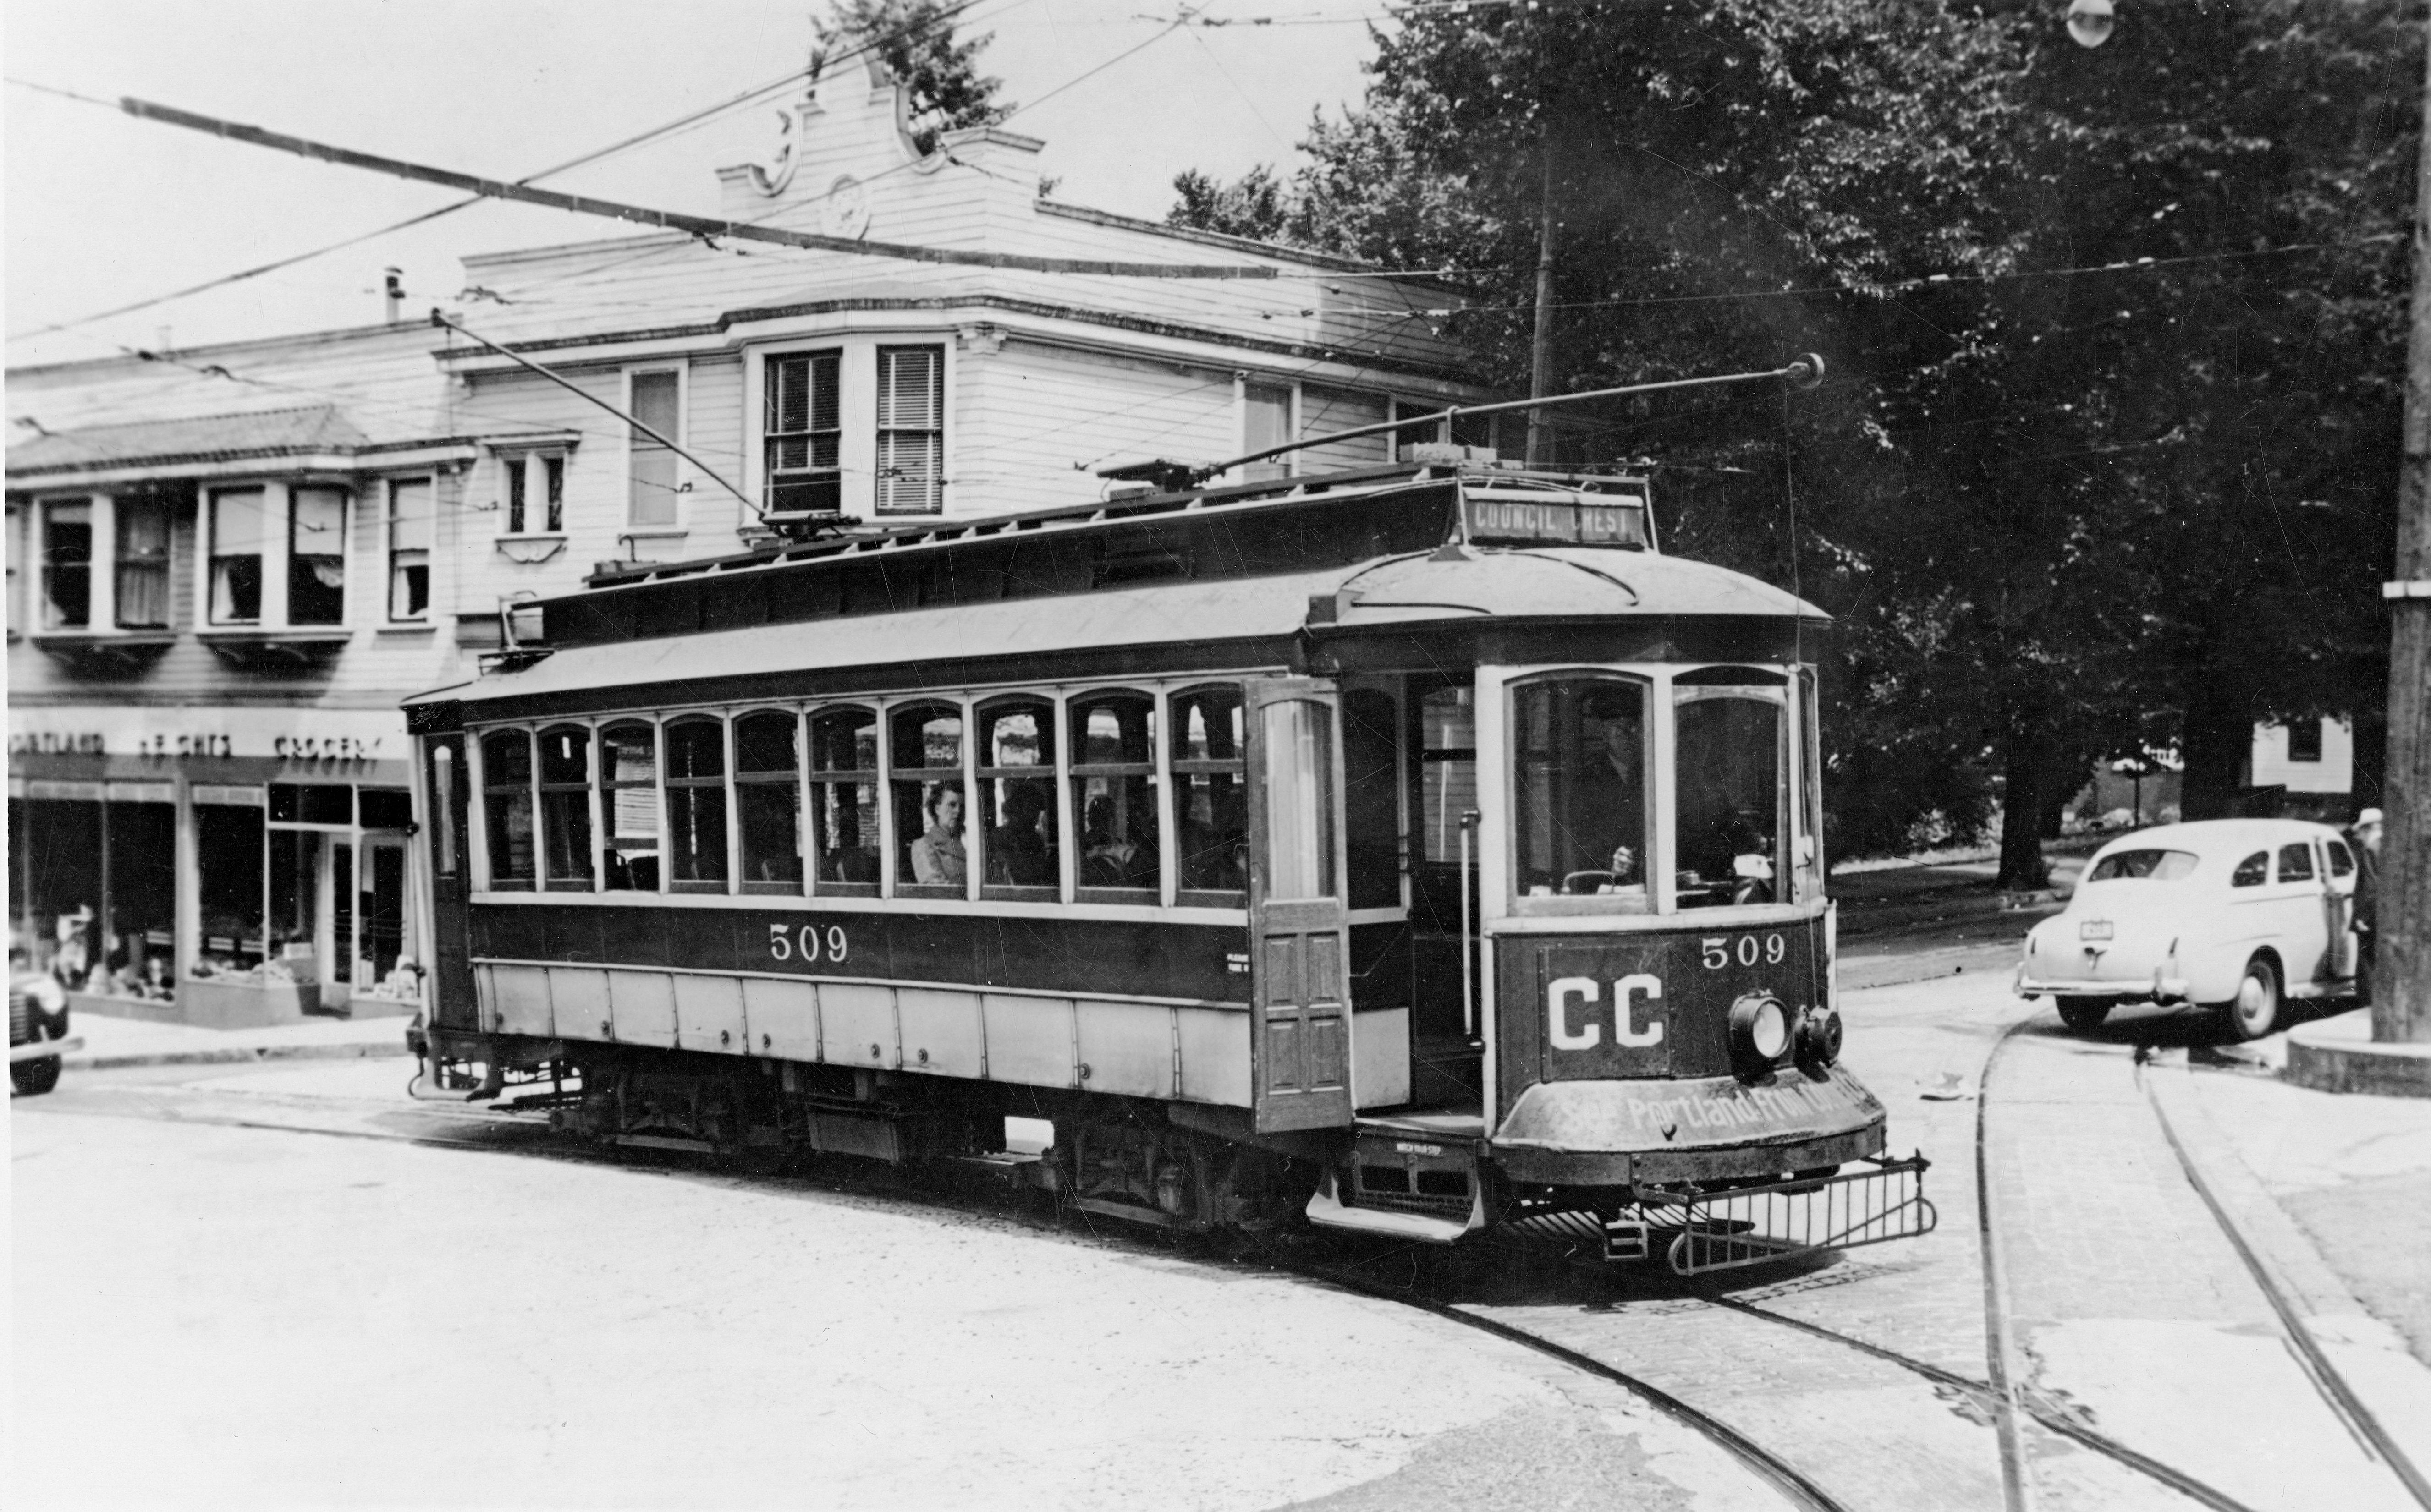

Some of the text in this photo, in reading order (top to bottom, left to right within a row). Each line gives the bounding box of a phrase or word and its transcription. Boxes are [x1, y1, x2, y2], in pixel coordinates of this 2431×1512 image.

[1475, 502, 1628, 533] COUNCIL CREST
[770, 923, 847, 962] 509
[1702, 934, 1785, 970] 509
[1627, 1090, 1759, 1129] Portland
[1748, 1086, 1813, 1121] From
